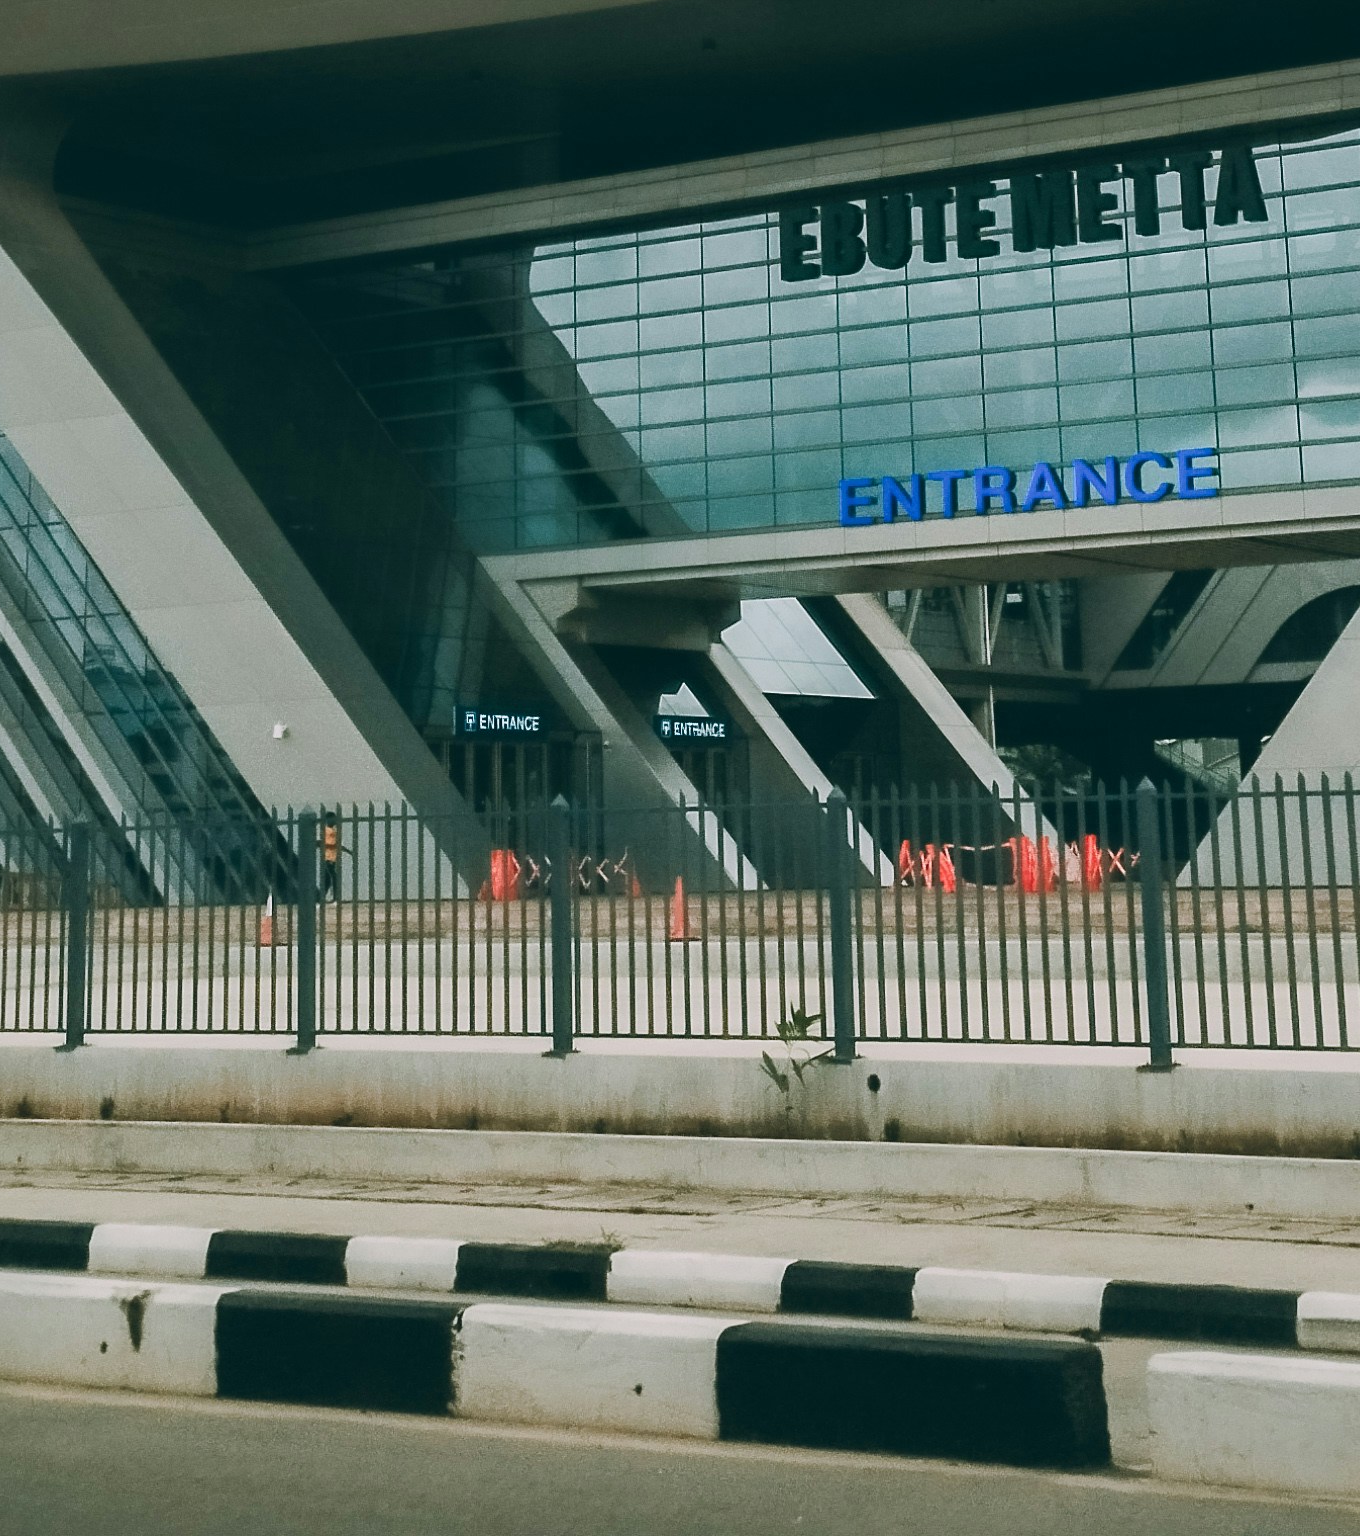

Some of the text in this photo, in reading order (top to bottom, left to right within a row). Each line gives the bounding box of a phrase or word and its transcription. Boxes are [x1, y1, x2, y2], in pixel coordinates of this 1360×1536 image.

[778, 144, 1269, 282] EBUTE METTA
[838, 446, 1219, 527] ENTRANCE
[479, 713, 540, 732] ENTRANCE
[673, 721, 726, 738] ENTRANCE
